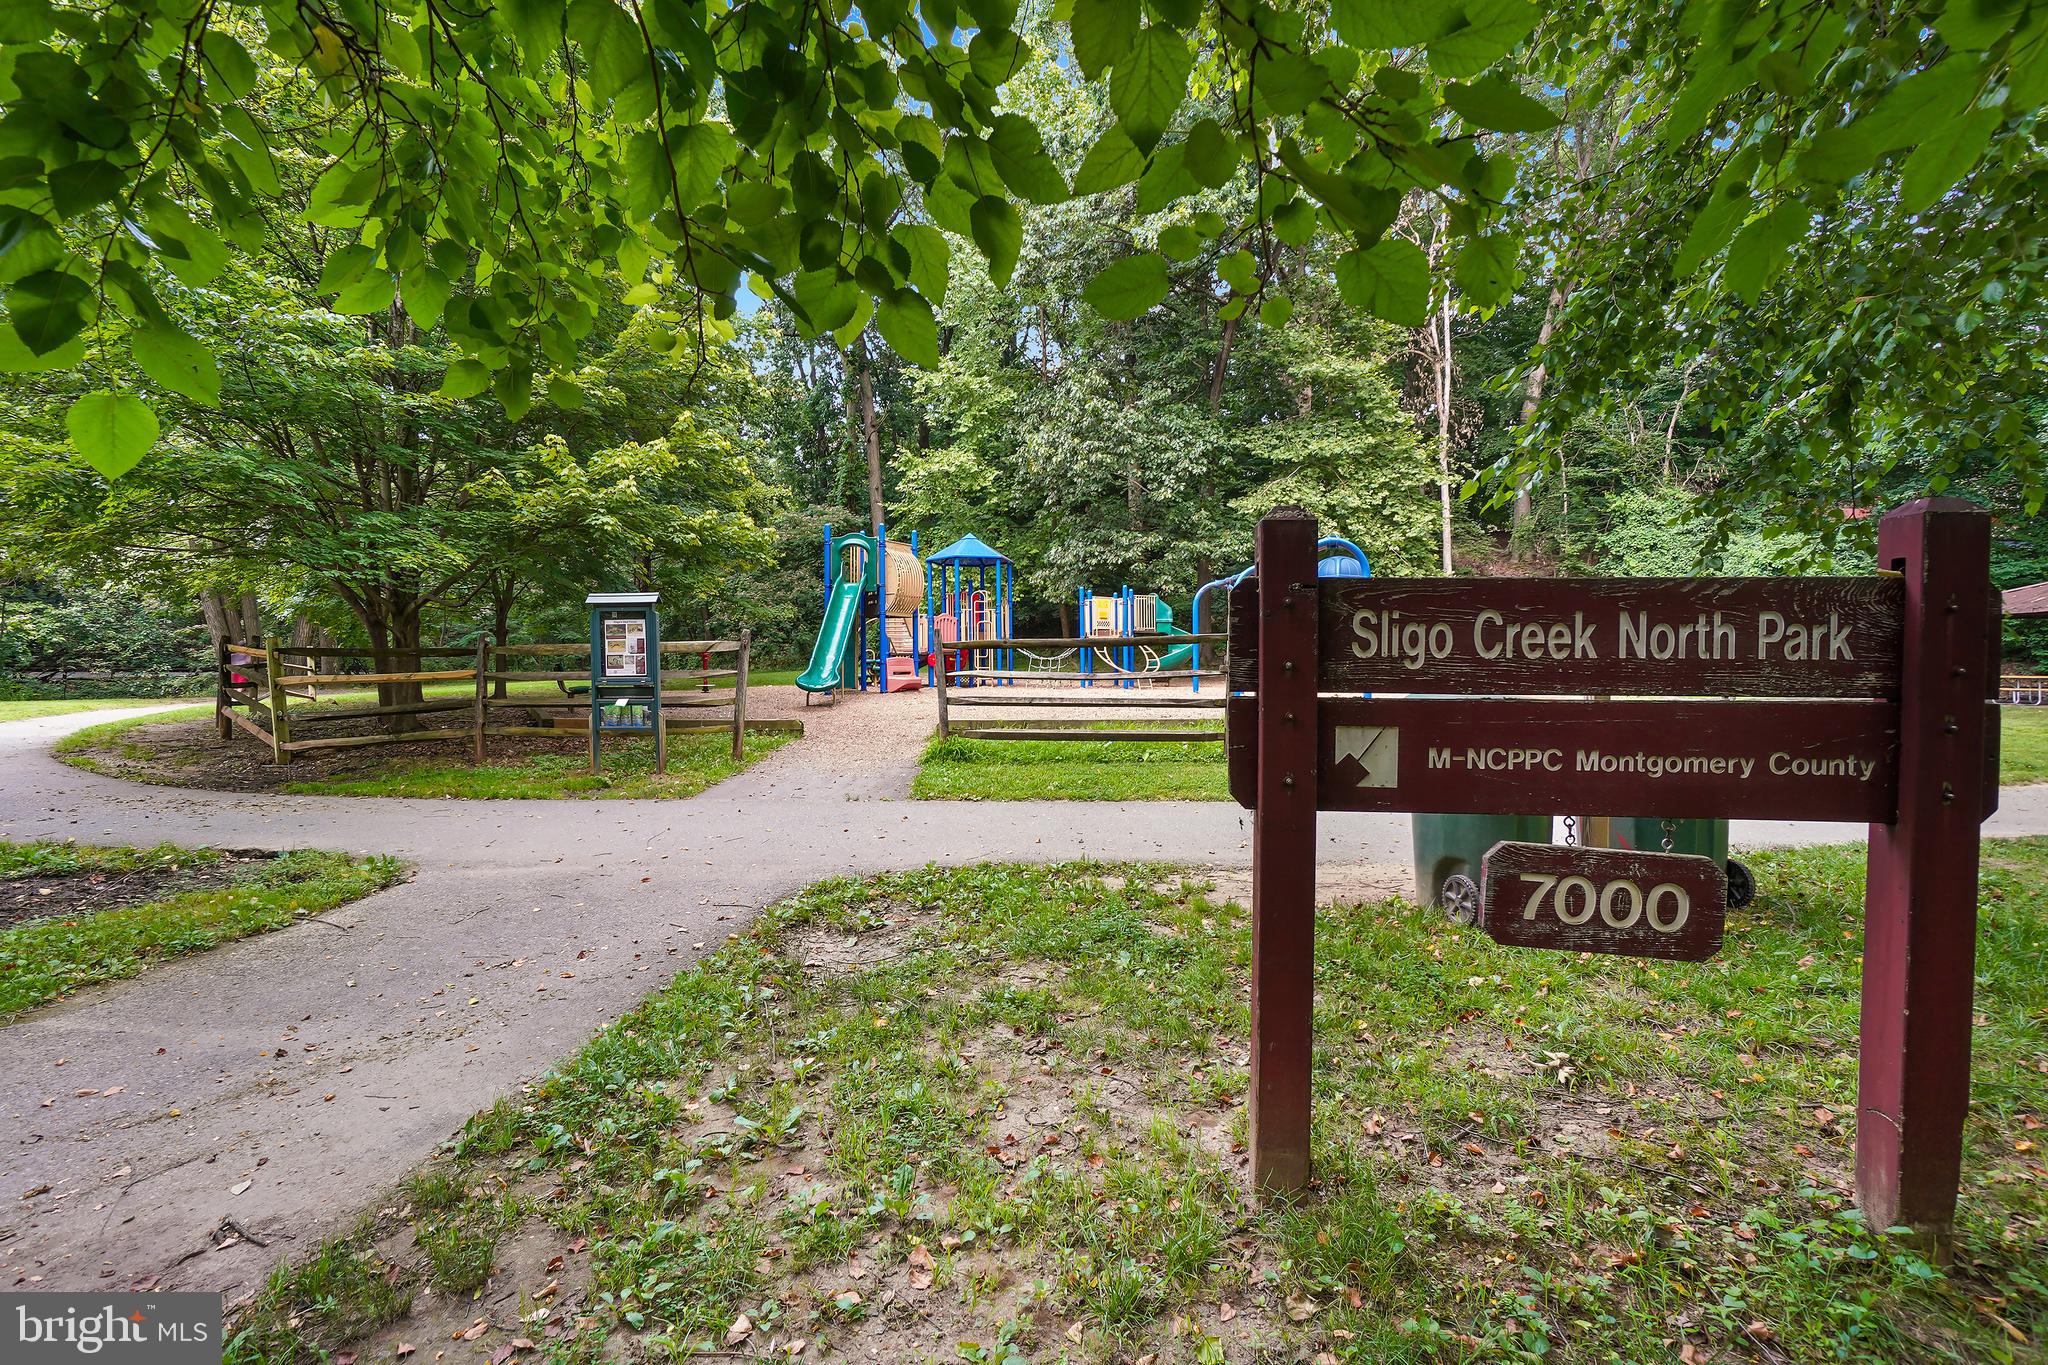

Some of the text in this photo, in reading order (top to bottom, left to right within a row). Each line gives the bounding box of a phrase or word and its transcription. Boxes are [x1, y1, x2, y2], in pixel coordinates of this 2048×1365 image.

[1351, 608, 1855, 671] Sligo Creek North Park
[1428, 746, 1876, 782] M-NCPPC Montgomery County
[1519, 872, 1690, 934] 7000
